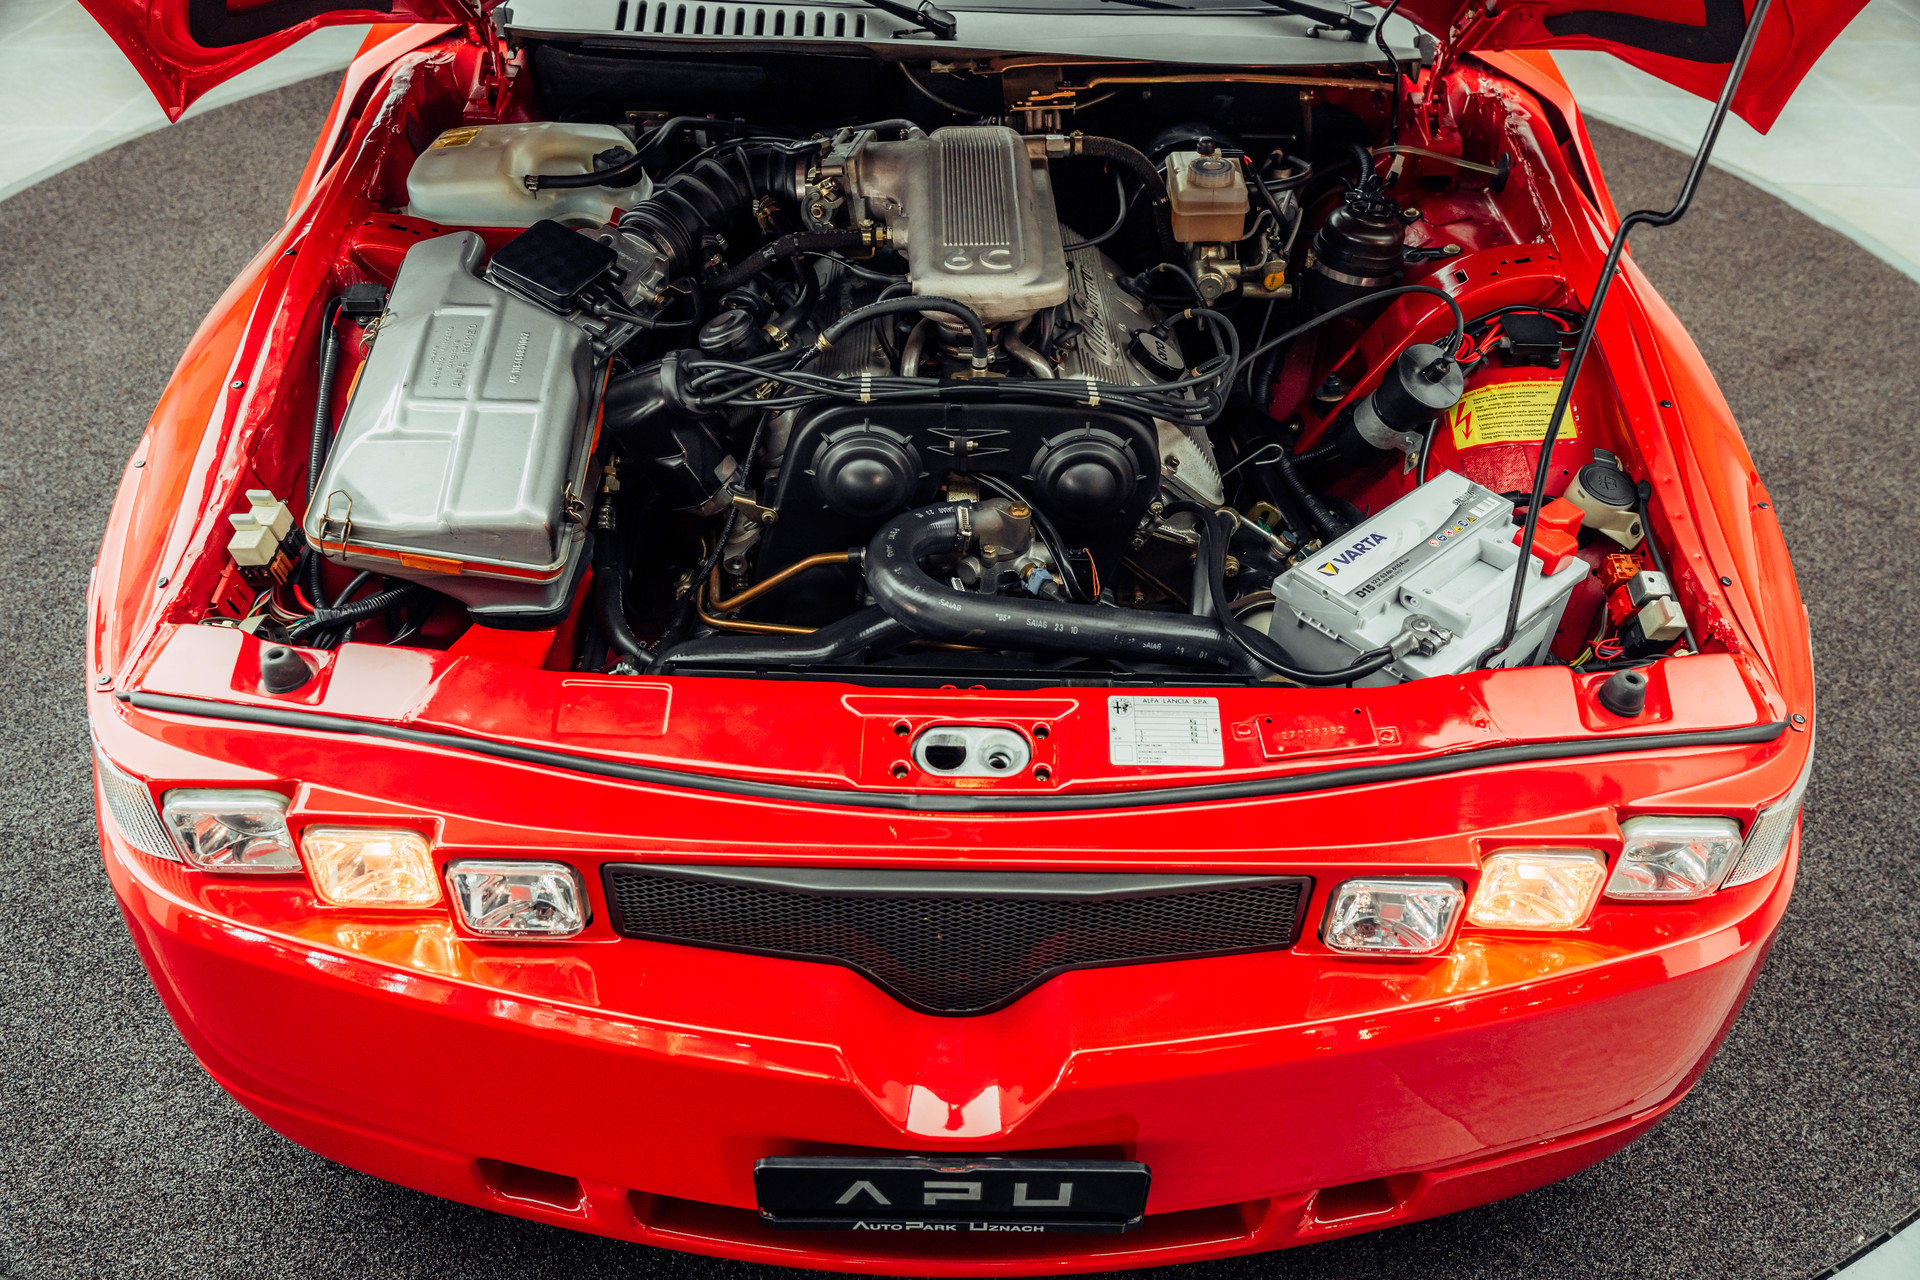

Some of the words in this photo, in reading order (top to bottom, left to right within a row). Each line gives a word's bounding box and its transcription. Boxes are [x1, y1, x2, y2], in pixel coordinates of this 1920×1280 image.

[451, 362, 468, 389] ALFA
[460, 323, 478, 355] ROMEO
[1155, 340, 1168, 361] OLIO
[1332, 532, 1388, 565] VARTA
[1354, 583, 1376, 599] D15
[939, 599, 962, 611] SAIAG
[1026, 618, 1048, 629] SAIAG
[1054, 623, 1064, 632] 23
[835, 1180, 1073, 1207] APU
